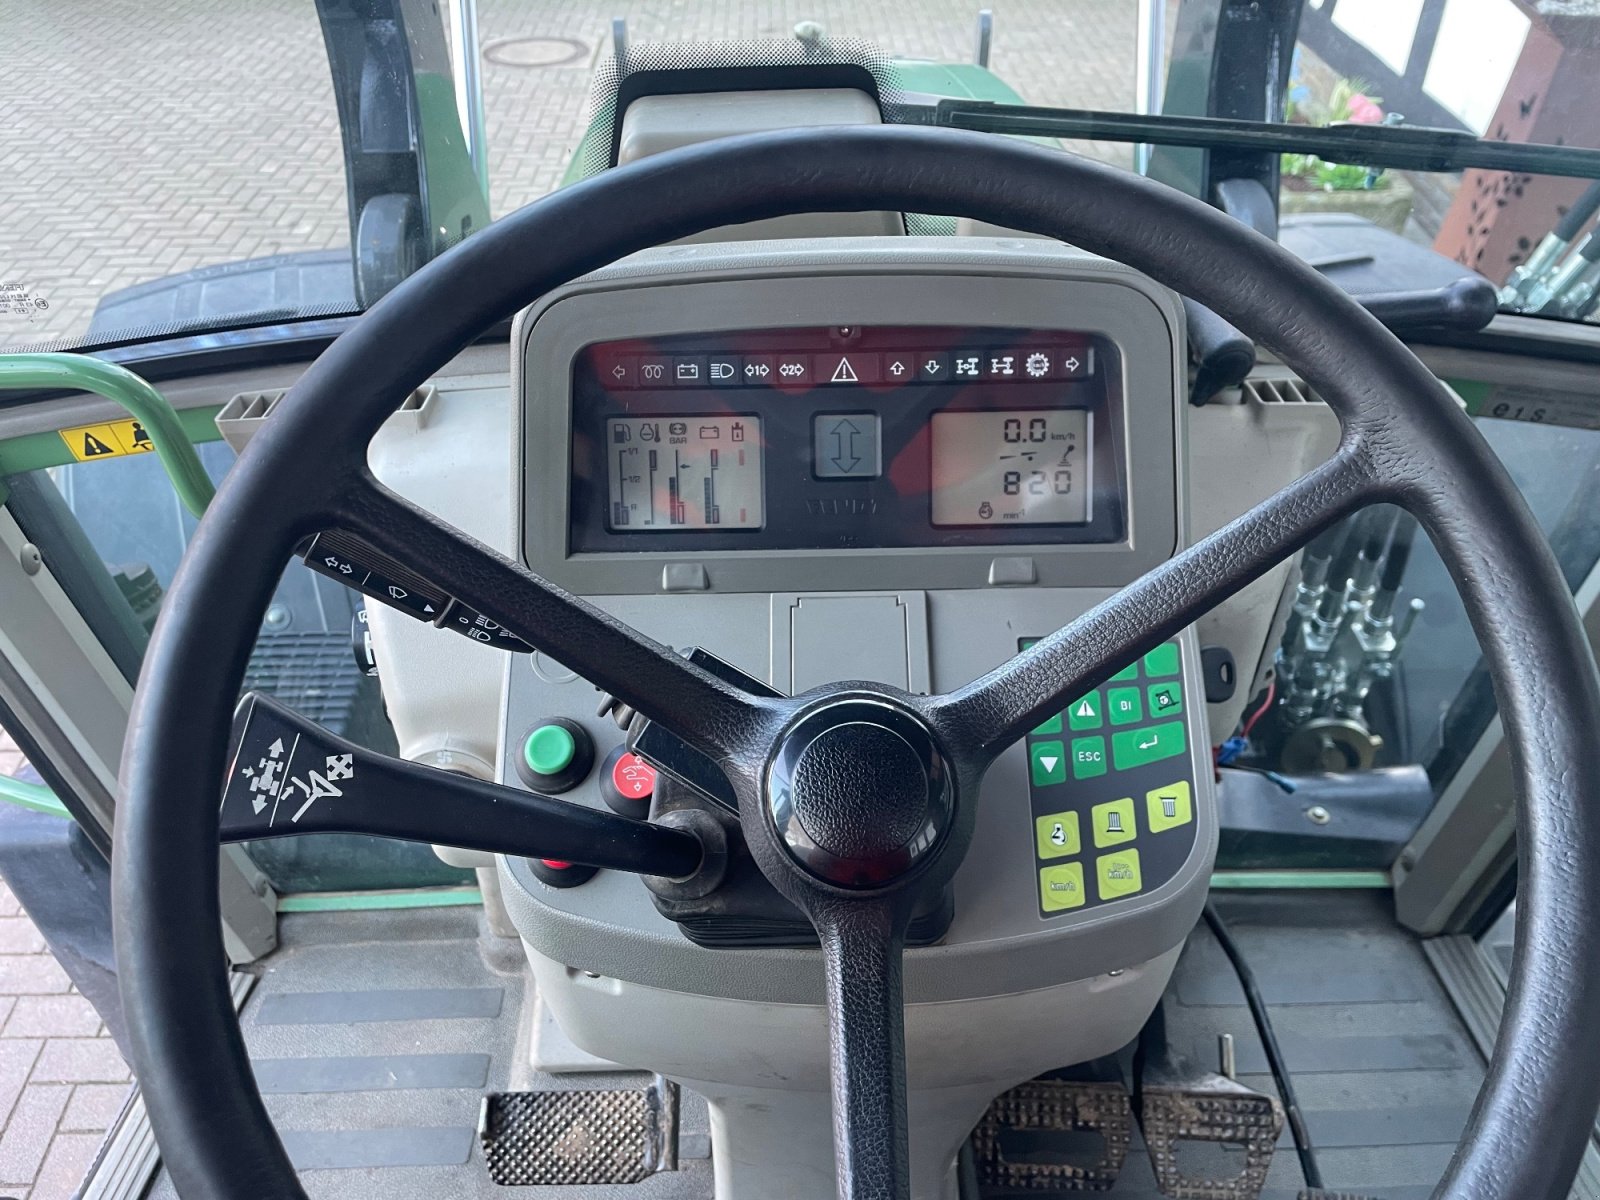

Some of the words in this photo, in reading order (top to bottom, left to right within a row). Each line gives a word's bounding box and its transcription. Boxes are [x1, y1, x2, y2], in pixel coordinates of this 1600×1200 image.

[1004, 418, 1047, 443] 0.0
[1051, 432, 1076, 441] km/h
[669, 437, 687, 445] BAR
[1004, 471, 1071, 495] 820
[1078, 751, 1101, 762] ESC
[1107, 869, 1133, 879] km/h
[1050, 881, 1076, 891] km/h
